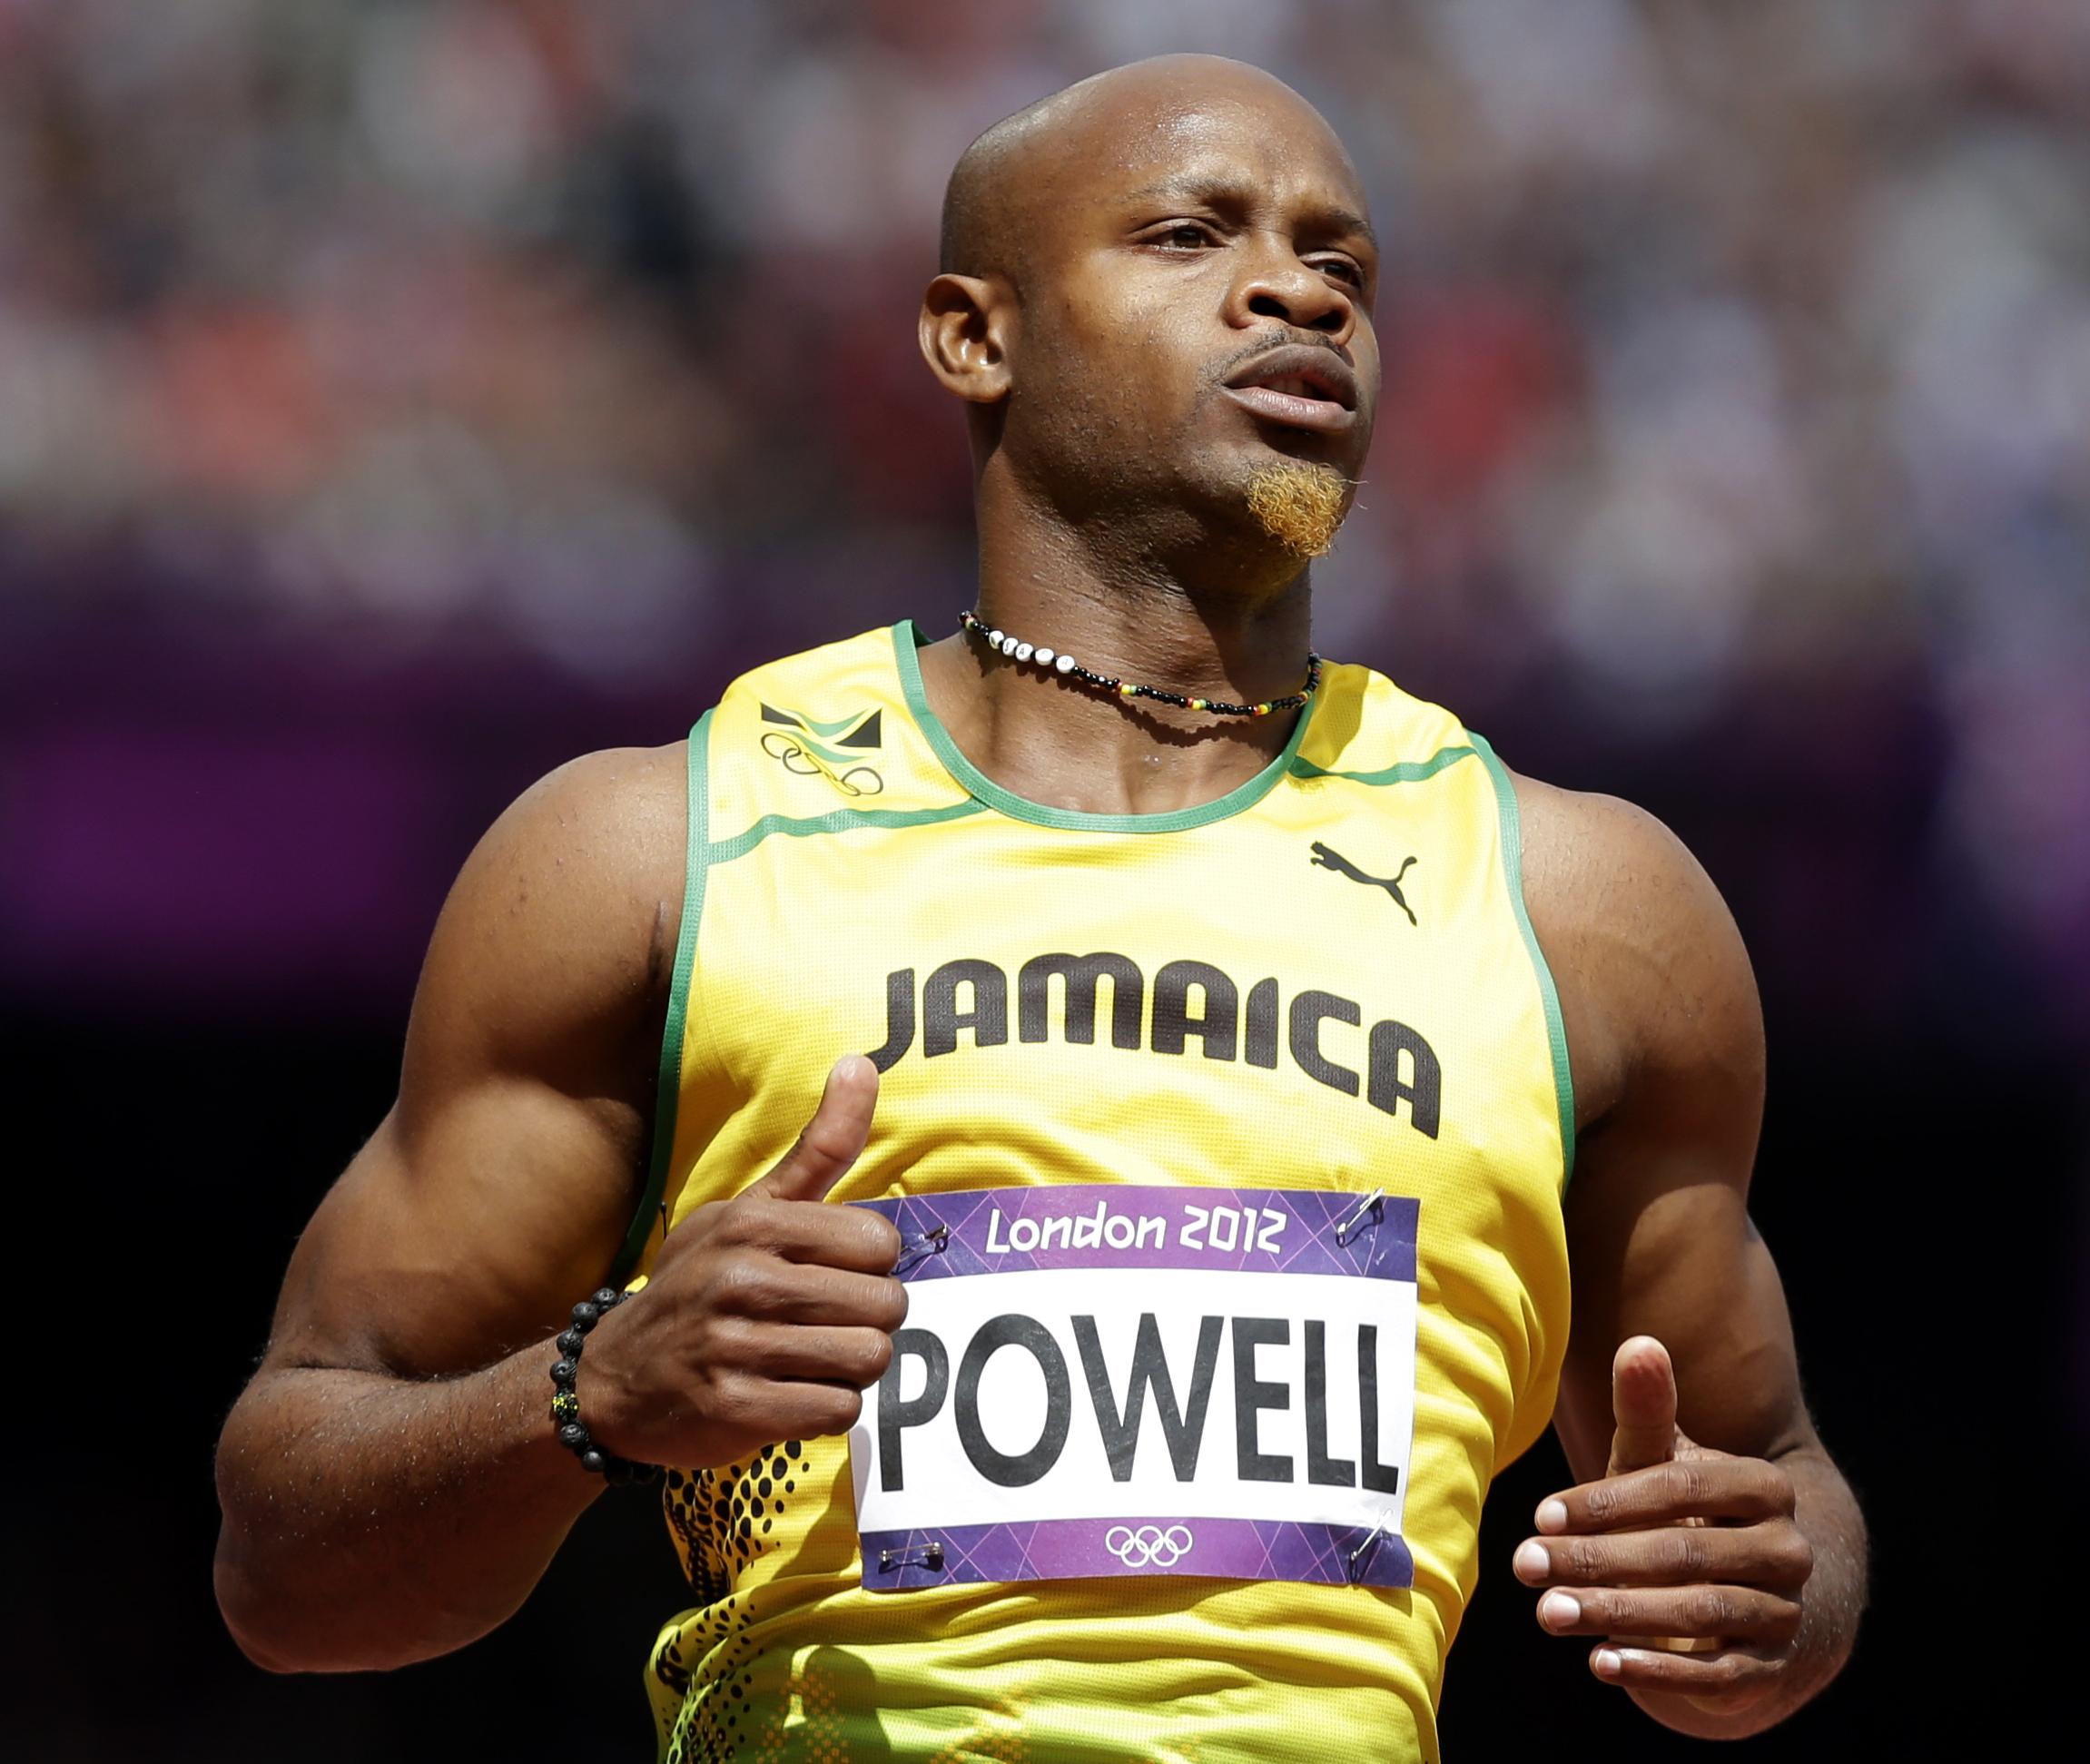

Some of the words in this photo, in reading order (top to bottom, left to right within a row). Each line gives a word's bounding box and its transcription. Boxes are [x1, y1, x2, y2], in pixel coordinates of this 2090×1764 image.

[863, 951, 1442, 1141] JAMAICA
[986, 1200, 1167, 1255] London
[1178, 1204, 1287, 1255] 2012
[876, 1312, 1399, 1495] POWELL
